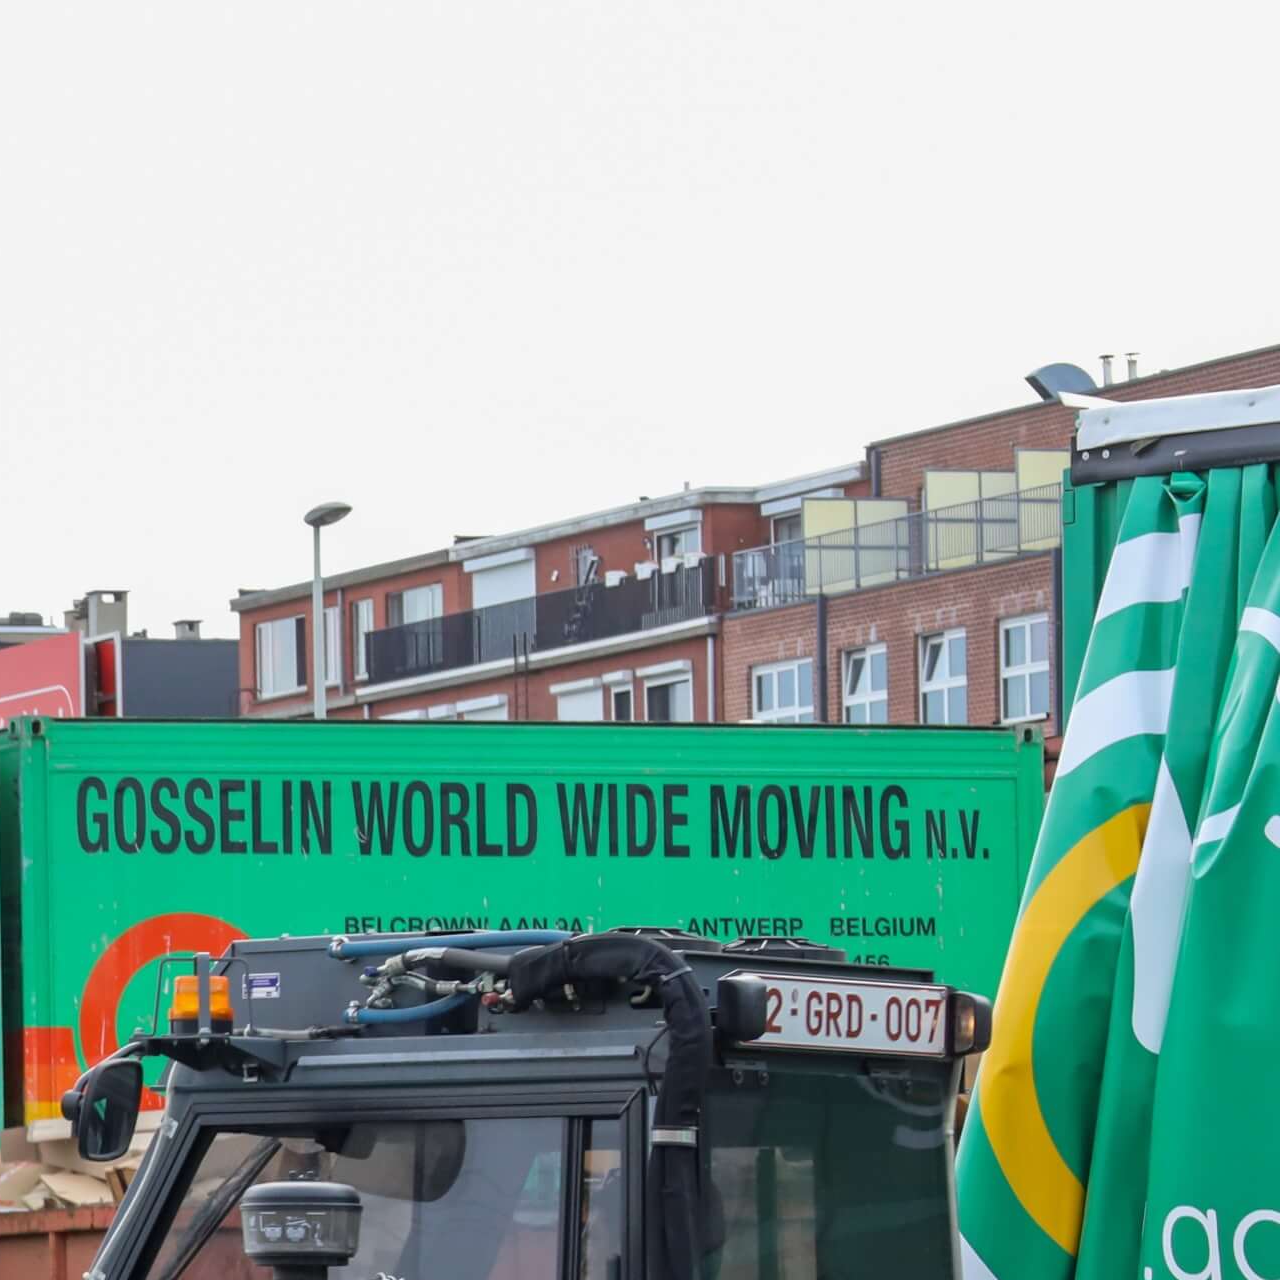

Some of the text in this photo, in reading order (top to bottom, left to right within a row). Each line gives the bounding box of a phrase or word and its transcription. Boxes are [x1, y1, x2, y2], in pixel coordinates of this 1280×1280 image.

[77, 777, 990, 859] GOSSELIN WORLD WIDE MOVING N.V.
[687, 917, 803, 936] ANTWERP
[830, 917, 936, 937] BELGIUM
